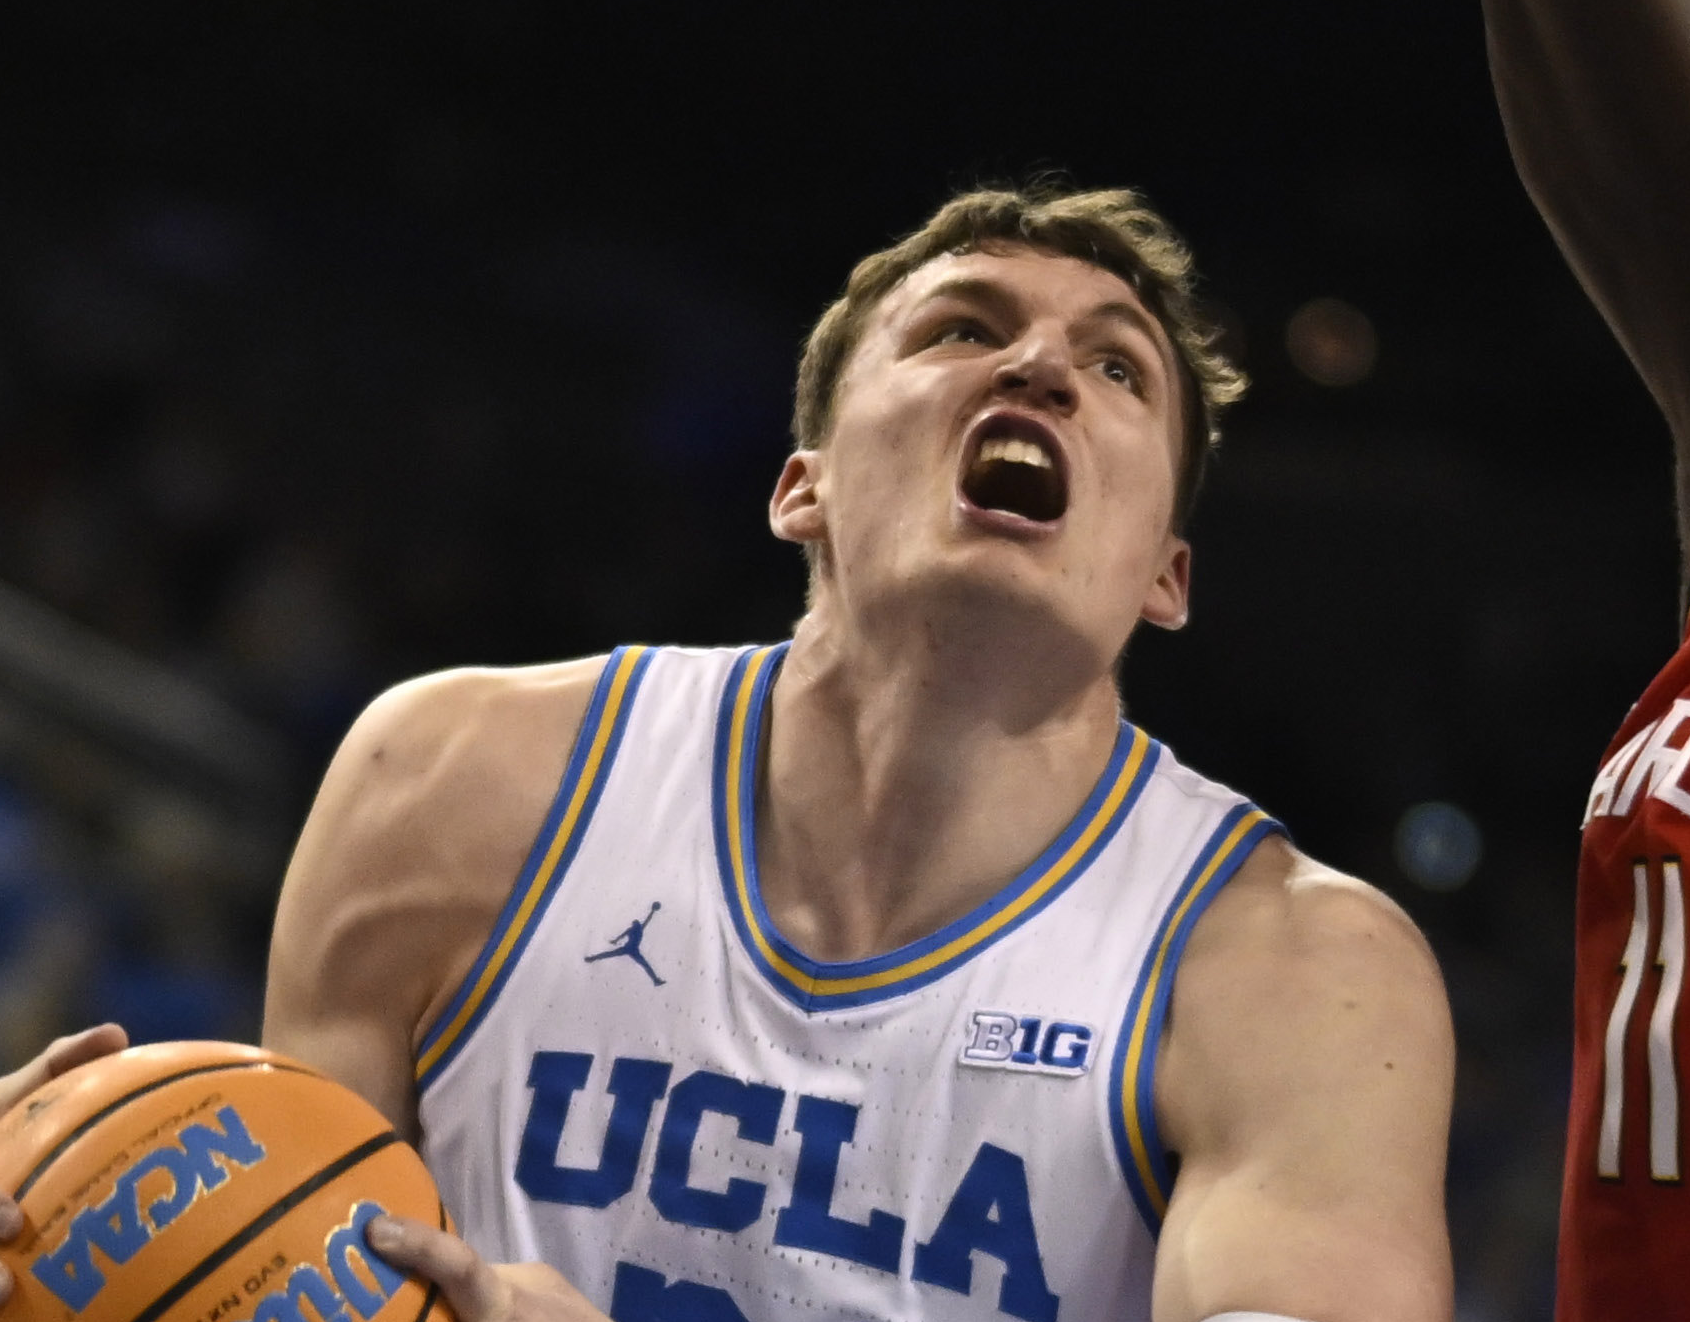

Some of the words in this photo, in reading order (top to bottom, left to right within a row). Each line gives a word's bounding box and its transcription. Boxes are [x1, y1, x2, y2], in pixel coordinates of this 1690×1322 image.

[1596, 855, 1686, 1185] 11
[30, 1104, 266, 1315] NCAA
[245, 1252, 288, 1295] EVO
